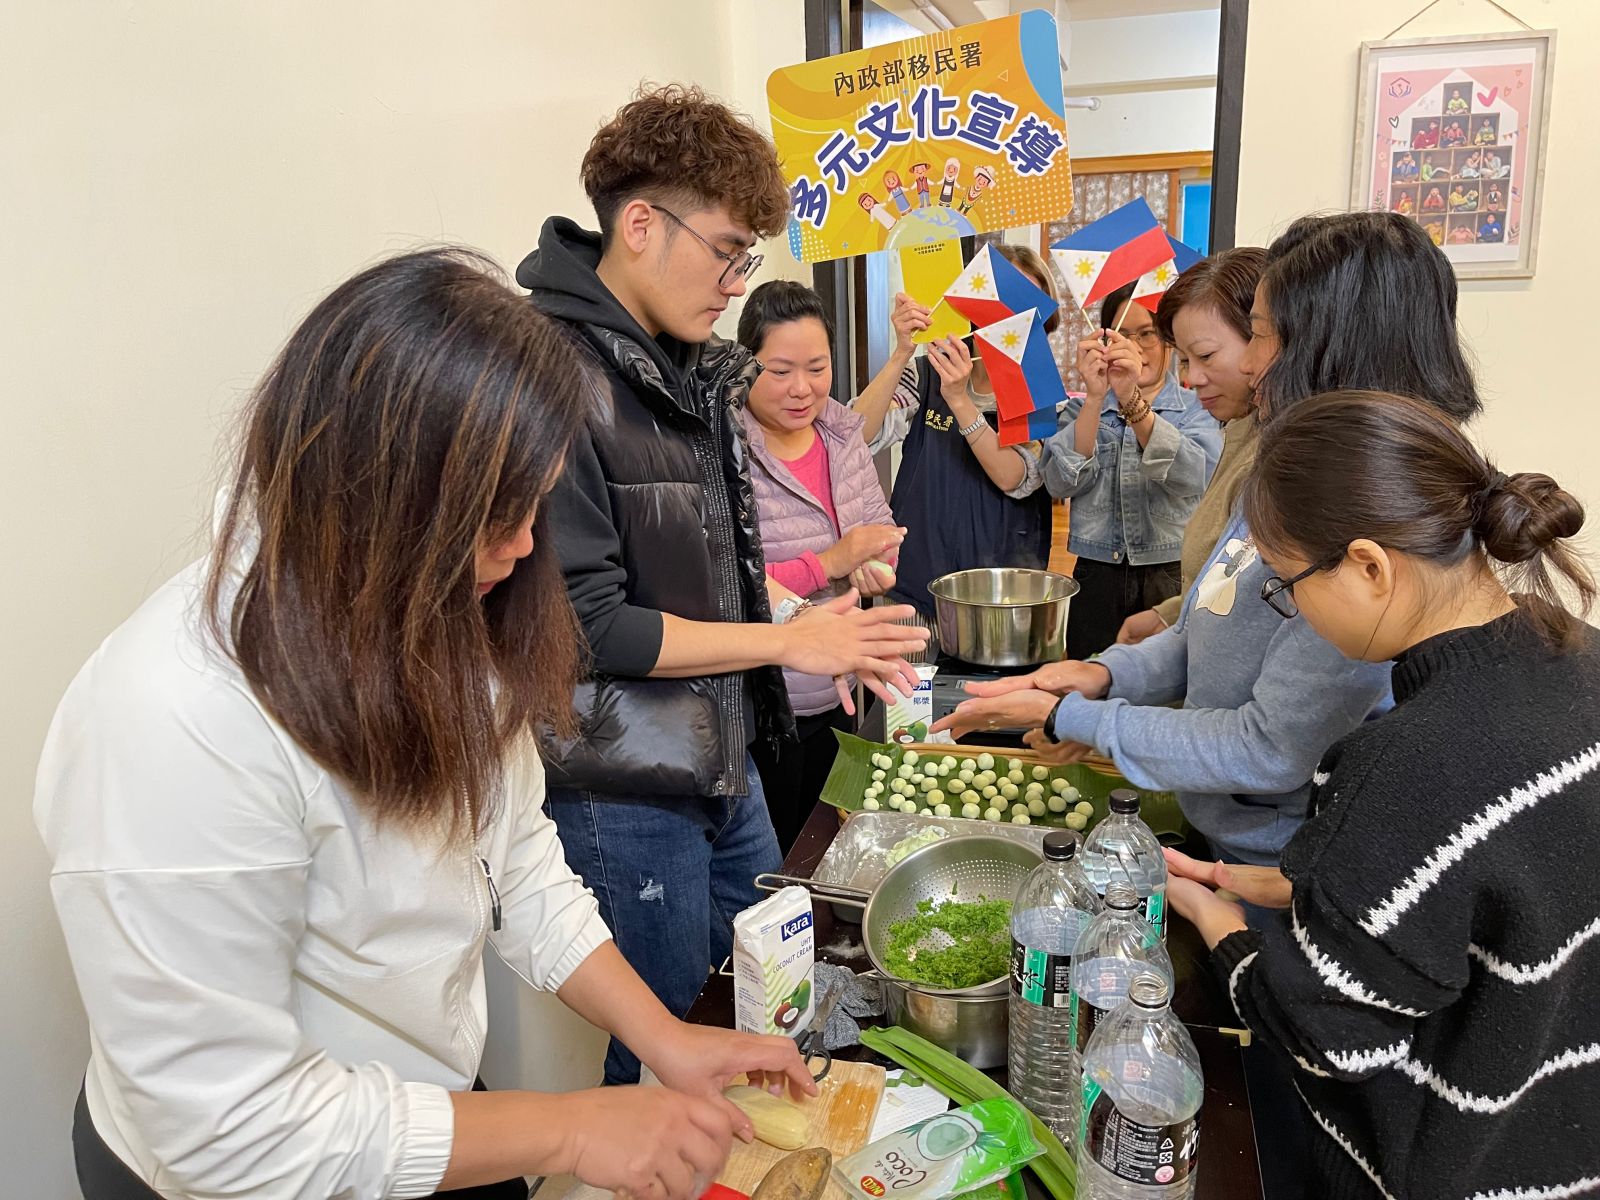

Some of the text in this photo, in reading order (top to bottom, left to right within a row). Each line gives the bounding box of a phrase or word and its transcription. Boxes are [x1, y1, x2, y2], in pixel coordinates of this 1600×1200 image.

[833, 41, 983, 97] 內政部移民署
[791, 87, 1063, 227] 多元文化宣導
[783, 915, 810, 937] kara
[800, 936, 812, 947] UHT
[773, 954, 796, 974] COCONUT
[796, 943, 813, 959] CREAM
